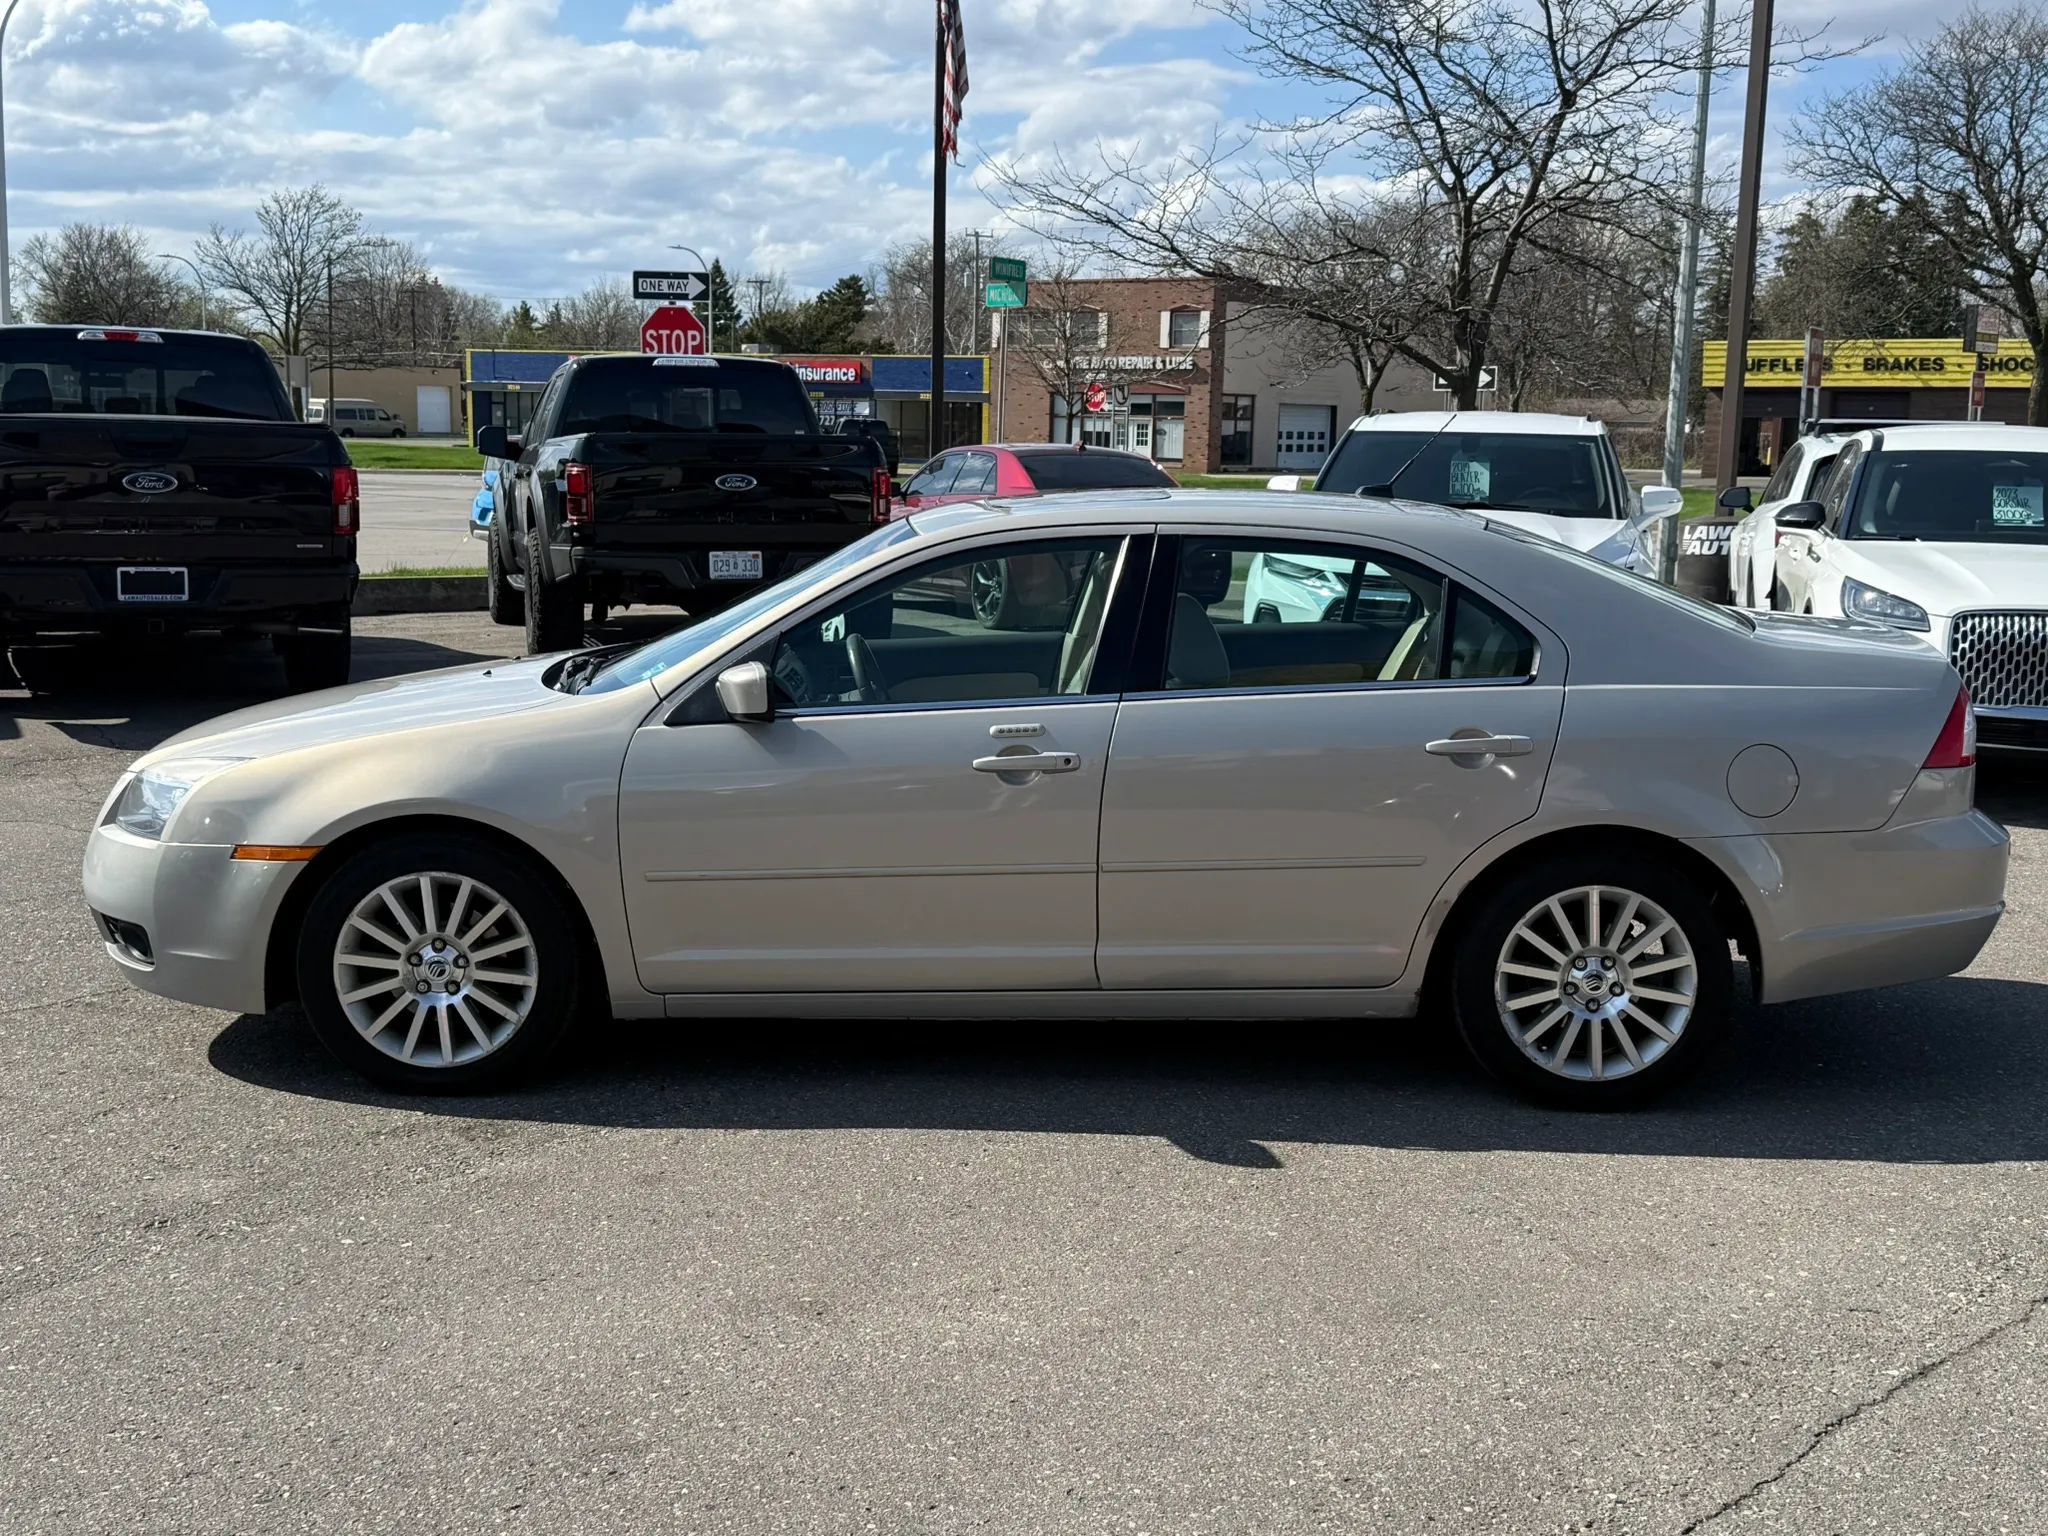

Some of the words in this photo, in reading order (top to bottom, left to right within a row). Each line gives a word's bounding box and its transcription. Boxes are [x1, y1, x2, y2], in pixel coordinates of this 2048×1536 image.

[640, 279, 665, 292] ONE
[667, 279, 689, 292] WAY
[645, 329, 701, 353] STOP
[1118, 356, 1153, 370] REPAIR
[1156, 357, 1162, 369] &
[1166, 356, 1194, 370] LUBE
[1745, 358, 1833, 372] UFFLES
[1863, 357, 1945, 372] BRAKES
[1979, 357, 2034, 372] SHOC
[796, 364, 856, 382] insurance
[136, 475, 165, 489] Ford
[725, 477, 748, 488] Ford
[1686, 540, 1731, 555] AUT
